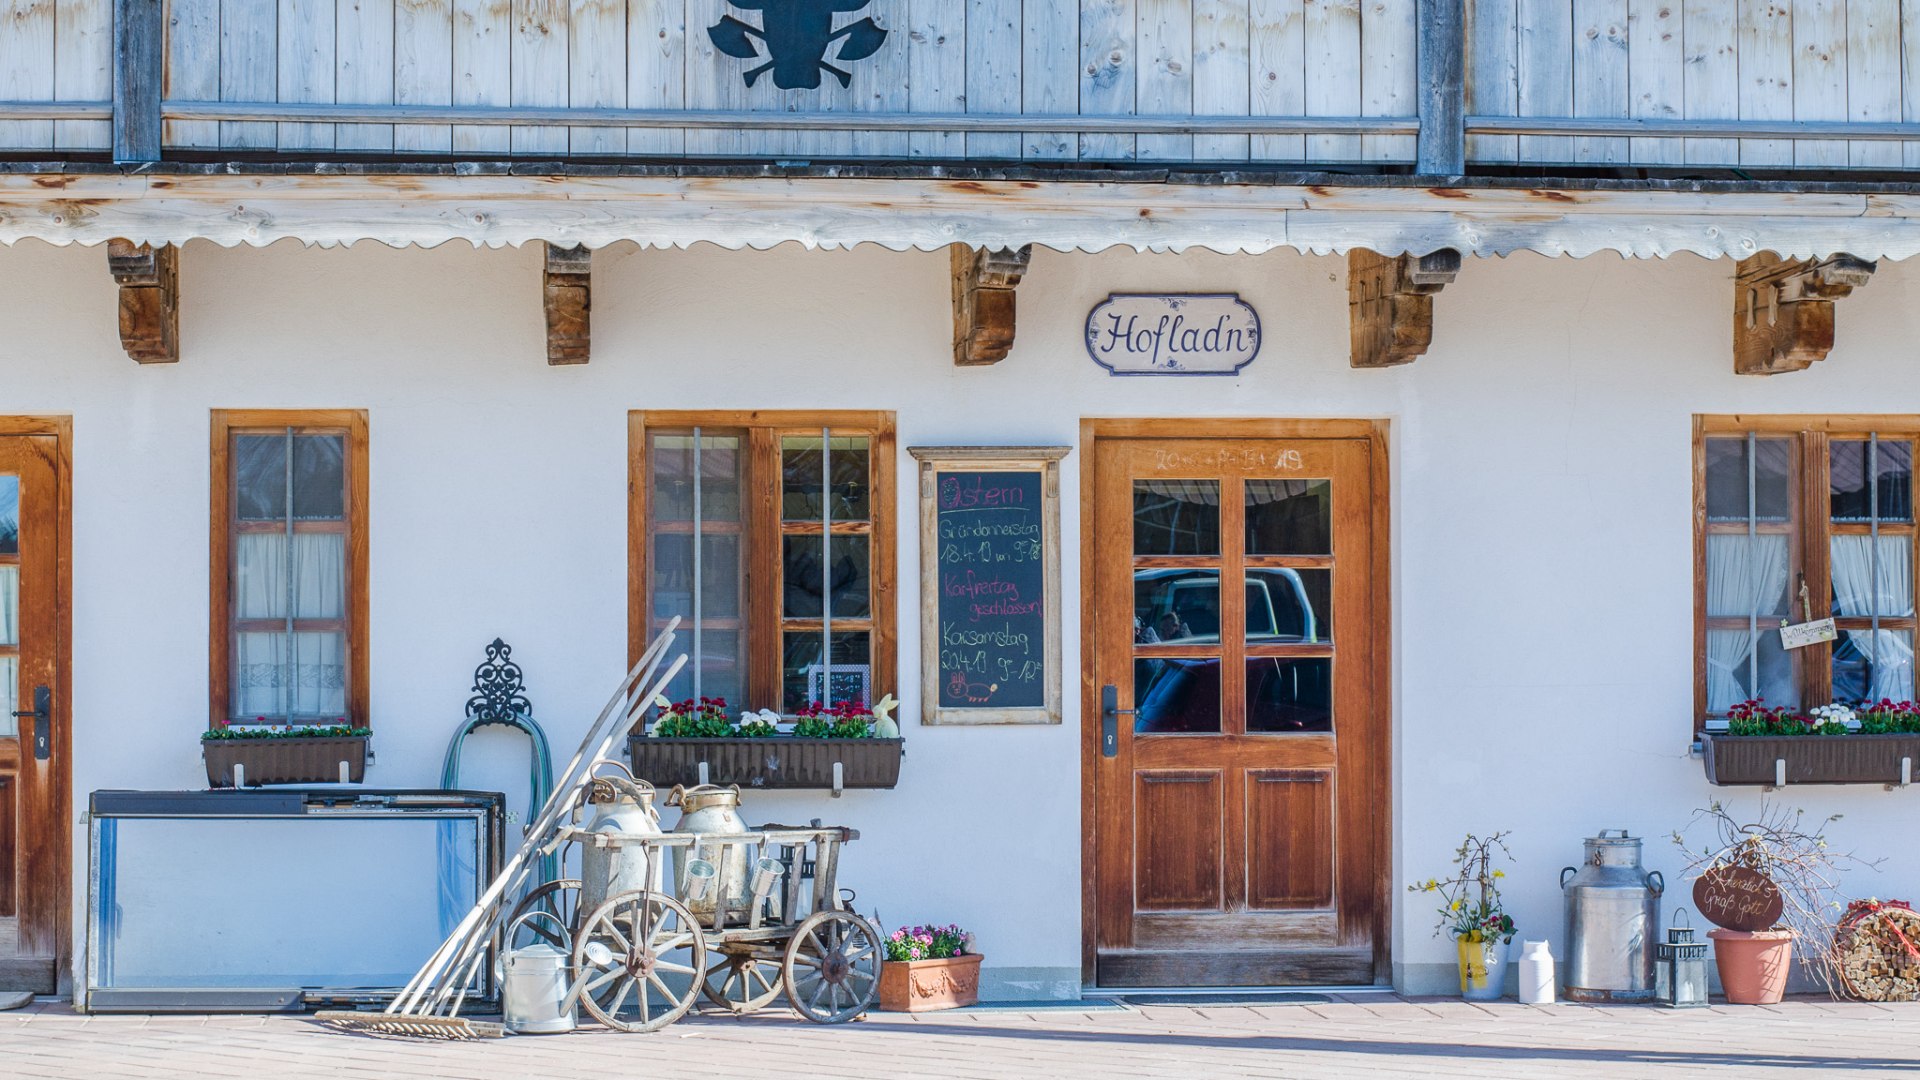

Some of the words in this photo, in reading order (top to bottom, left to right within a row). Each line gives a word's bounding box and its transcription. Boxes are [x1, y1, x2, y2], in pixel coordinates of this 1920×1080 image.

[1101, 314, 1248, 364] Hoflad'n
[940, 476, 1023, 508] Ostern
[945, 570, 1019, 601] Karfreitag
[943, 621, 1029, 654] Karsamstag
